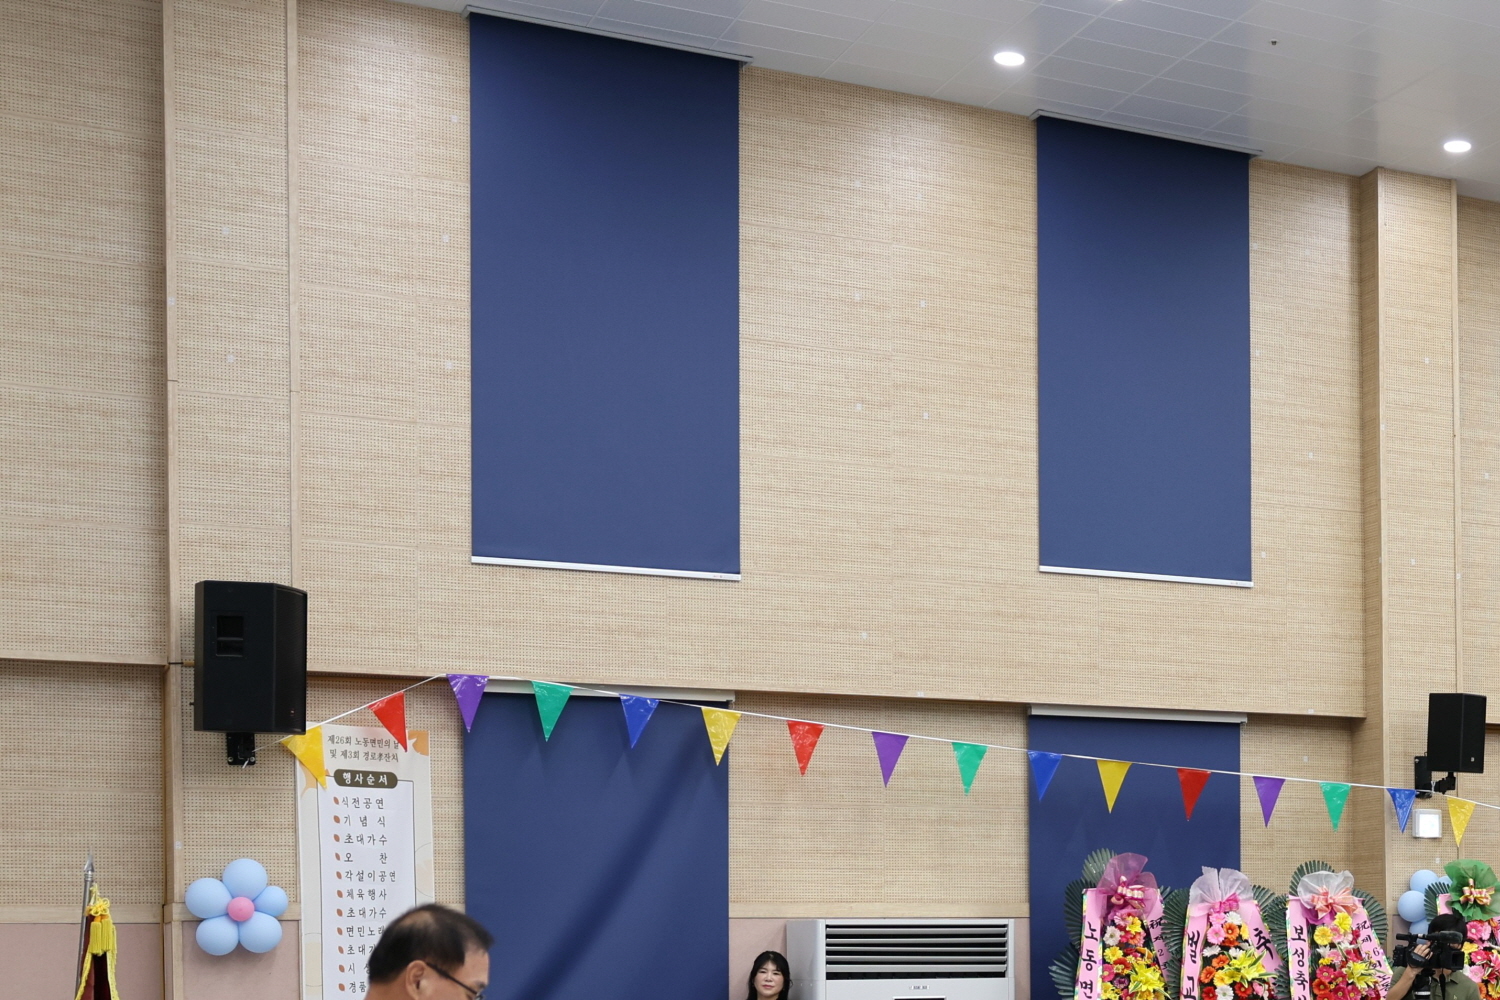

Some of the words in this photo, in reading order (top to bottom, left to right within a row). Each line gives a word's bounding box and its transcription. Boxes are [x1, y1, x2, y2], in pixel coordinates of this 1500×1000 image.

[327, 734, 352, 746] 제26회
[355, 737, 391, 749] 노동면민의
[329, 748, 337, 759] 및
[340, 749, 360, 761] 제3회
[342, 772, 388, 786] 행사순서
[342, 796, 384, 810] 식전공연
[343, 833, 388, 846] 초대가수
[344, 869, 396, 883] 각설이공연
[346, 888, 387, 901] 체육행사
[346, 906, 387, 919] 초대가수
